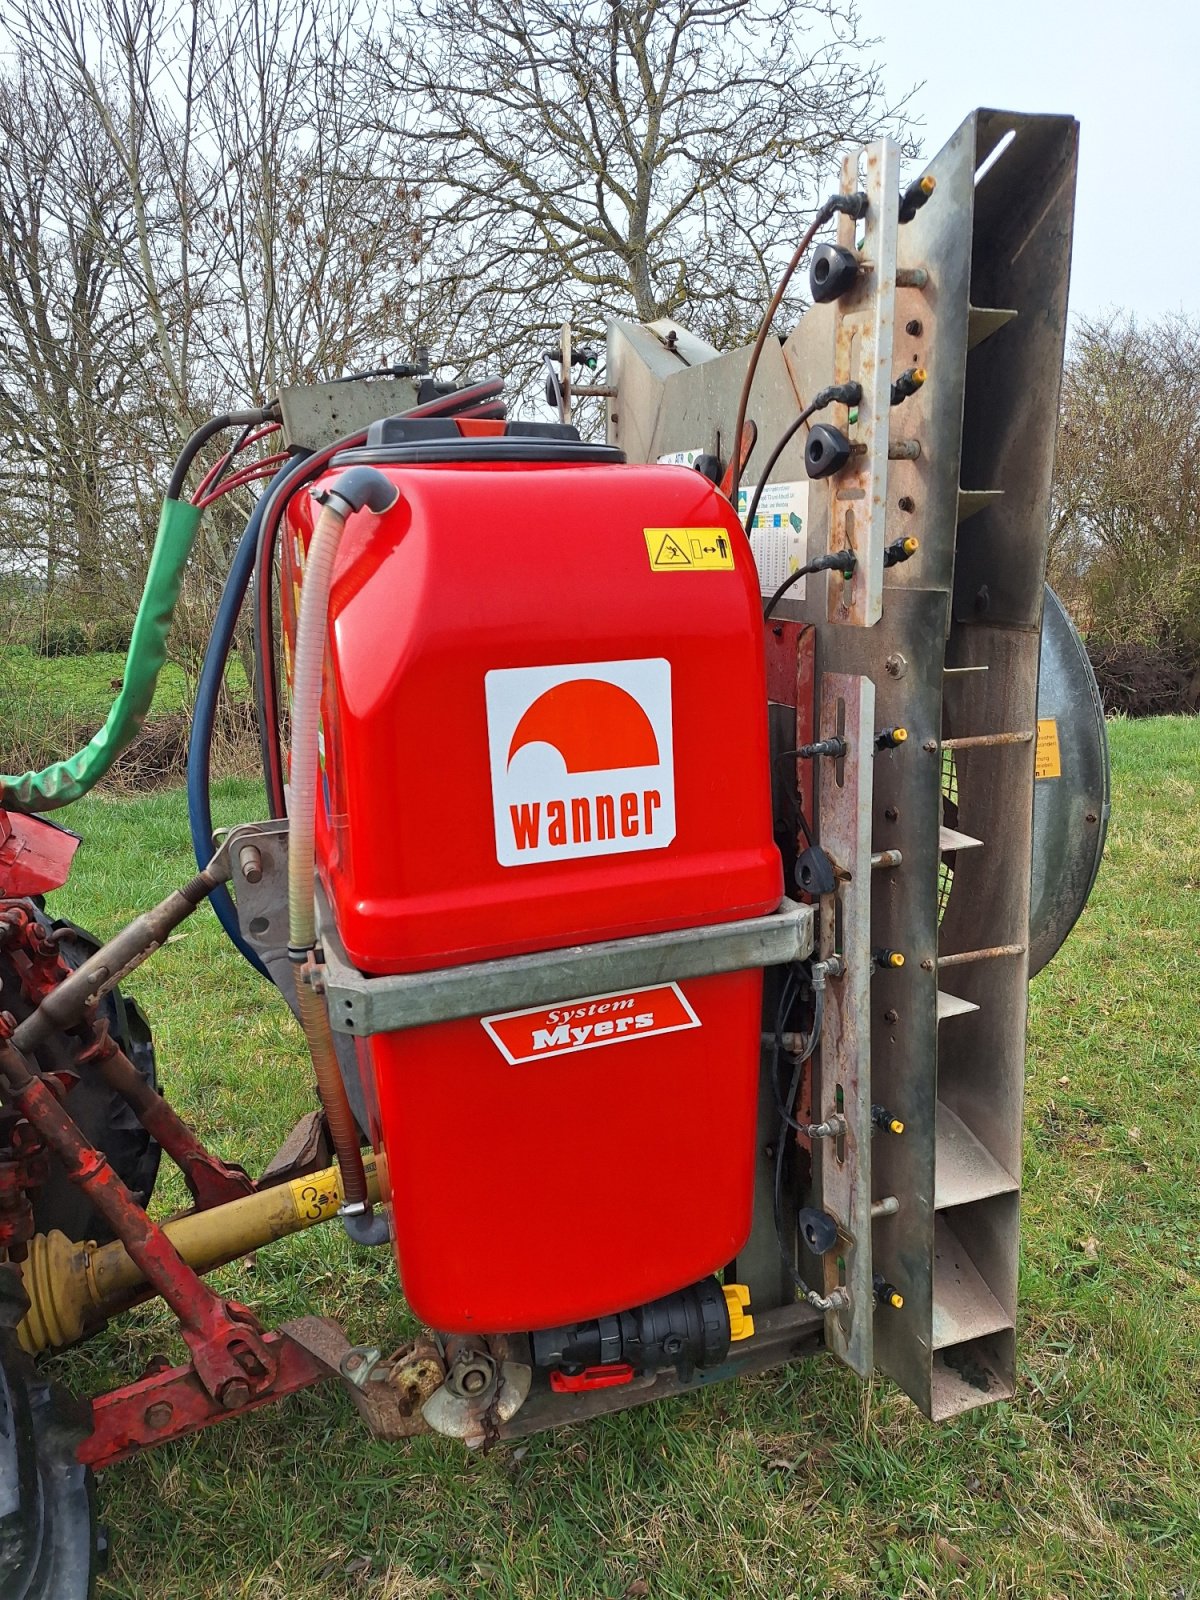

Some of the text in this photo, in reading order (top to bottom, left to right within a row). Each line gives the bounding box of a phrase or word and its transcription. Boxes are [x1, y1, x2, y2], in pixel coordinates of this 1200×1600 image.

[509, 789, 661, 850] wanner
[546, 998, 635, 1025] System
[531, 1012, 654, 1050] Myers
